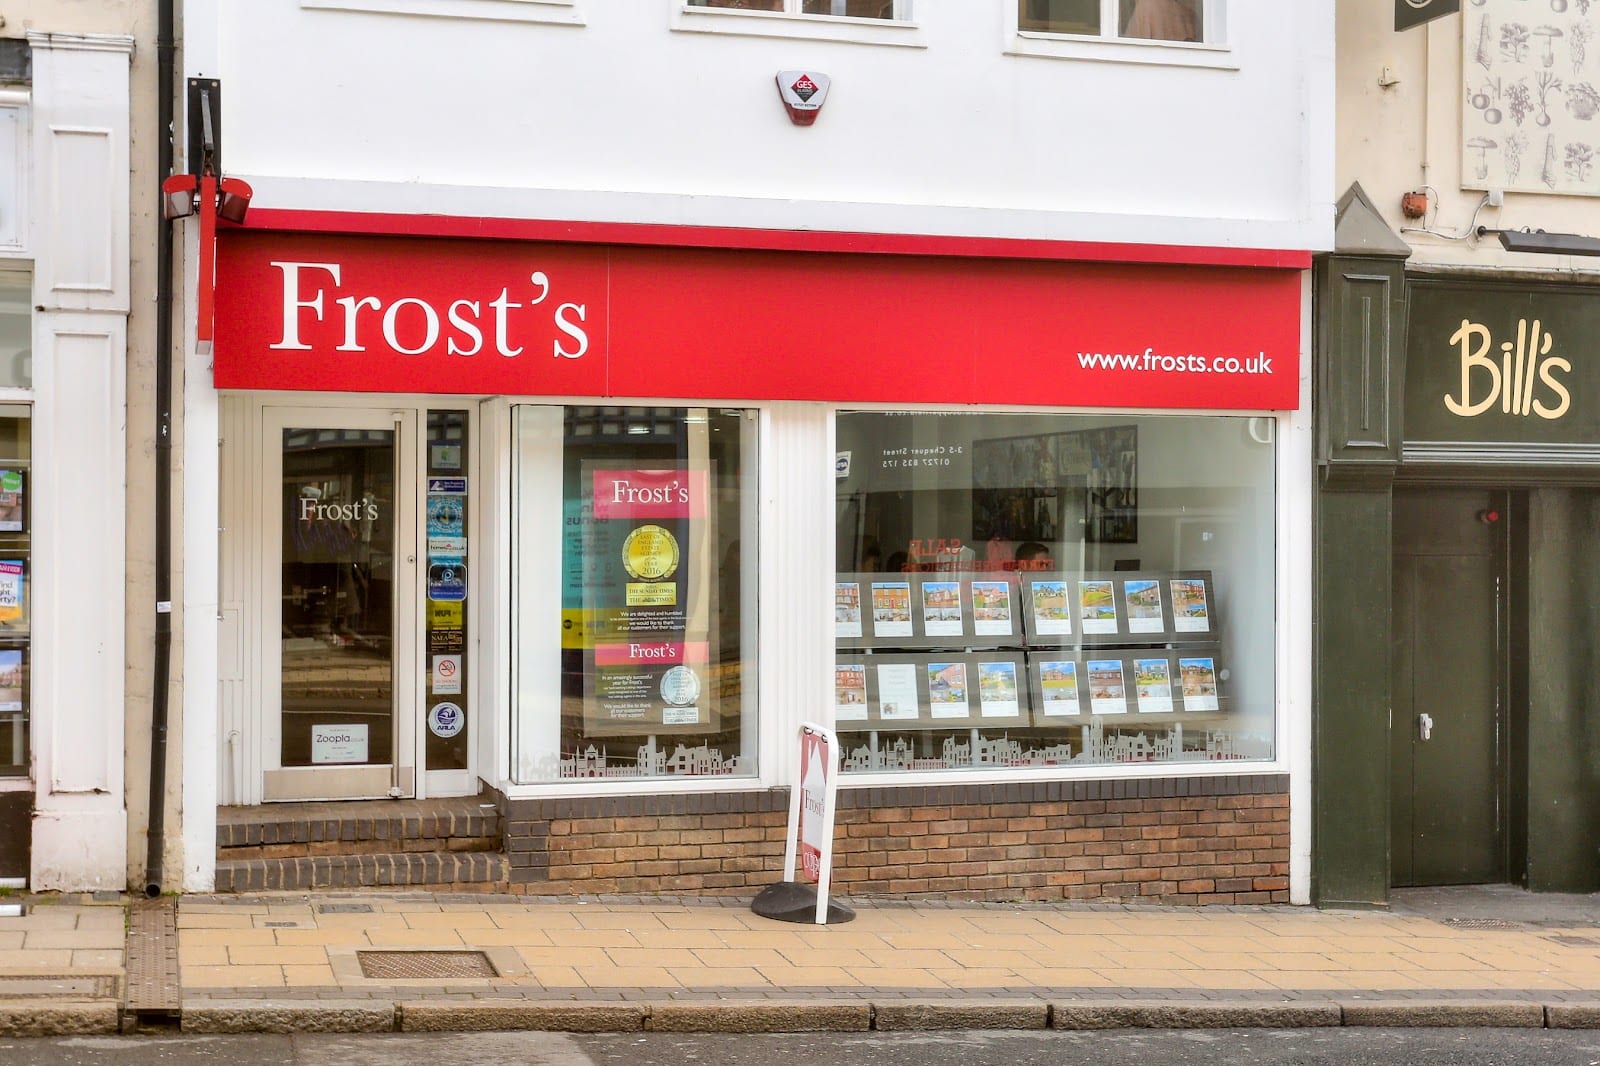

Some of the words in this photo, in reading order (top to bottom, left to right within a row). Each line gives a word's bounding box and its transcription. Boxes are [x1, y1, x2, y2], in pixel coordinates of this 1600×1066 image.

[796, 80, 813, 89] GES
[270, 261, 589, 359] Frost's
[1077, 347, 1273, 375] www.frosts.co.uk
[1444, 319, 1572, 420] Bill's
[611, 480, 689, 503] Frost's
[299, 497, 378, 521] Frost's
[642, 567, 661, 575] 2016
[629, 643, 676, 658] Frost's
